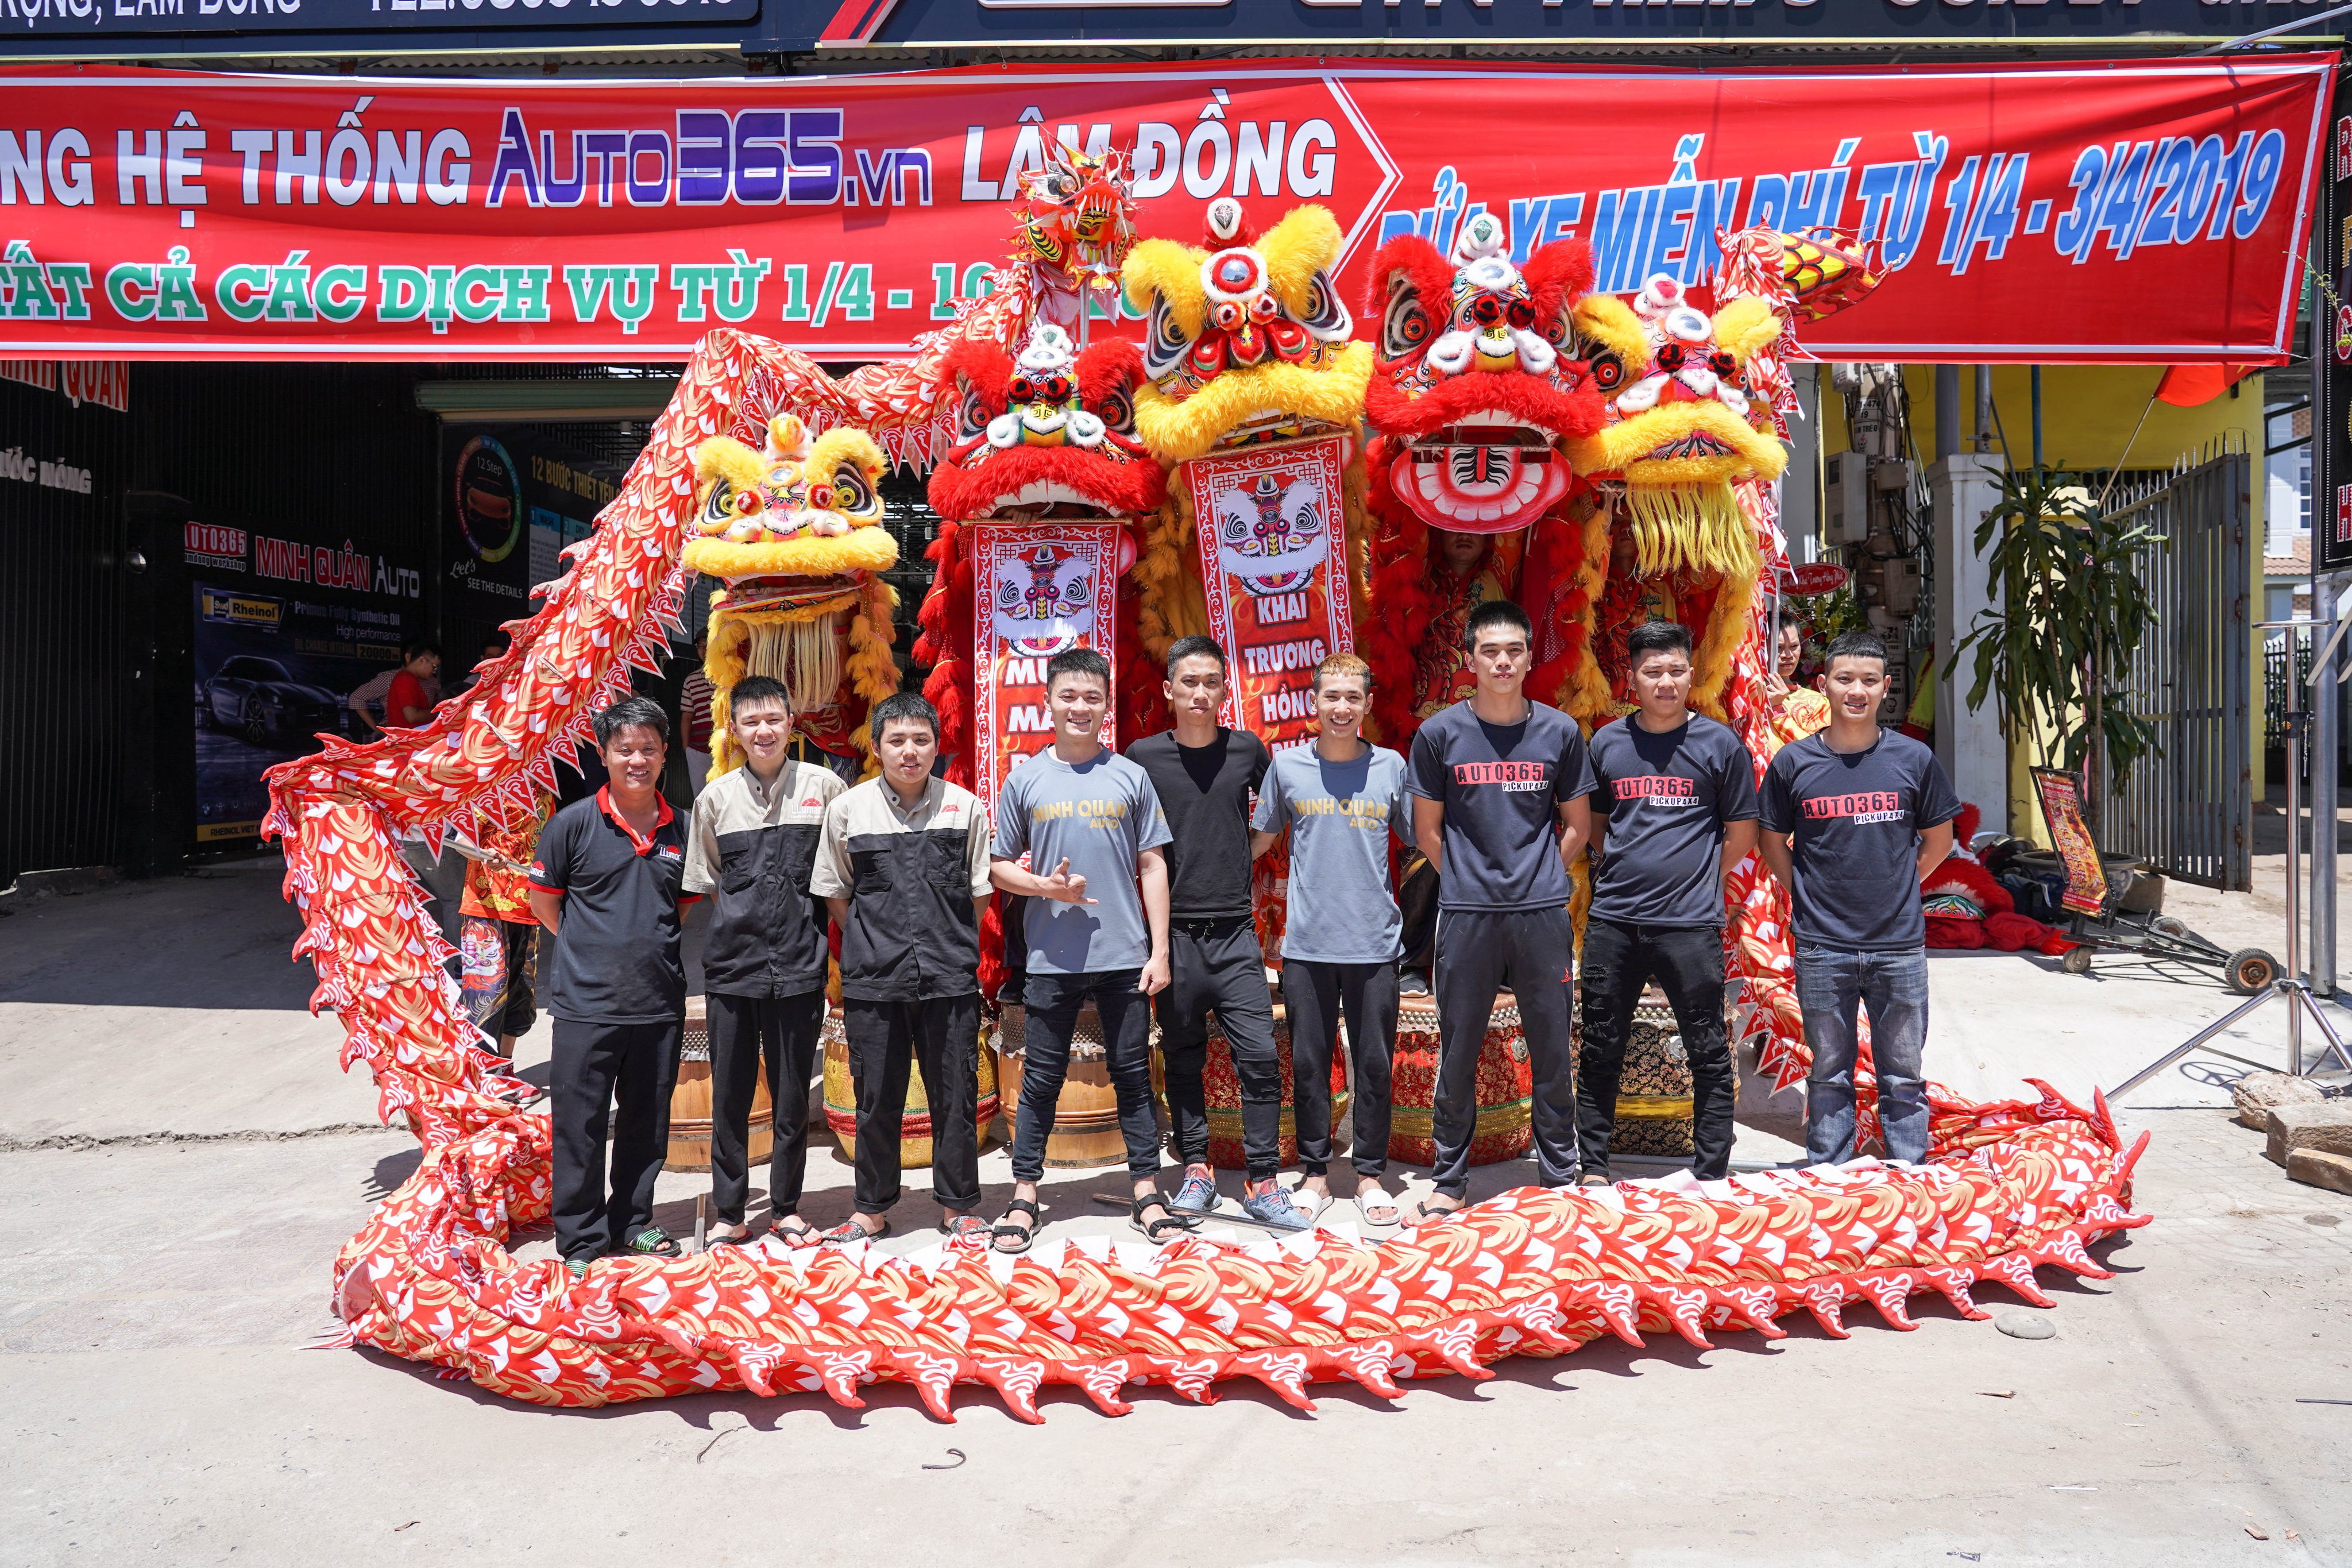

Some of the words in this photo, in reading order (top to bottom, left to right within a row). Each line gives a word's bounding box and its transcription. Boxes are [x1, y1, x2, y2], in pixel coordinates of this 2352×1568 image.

[117, 110, 207, 228] HỆ
[231, 95, 472, 206] THỐNG
[1131, 87, 1337, 199] ĐỒNG
[1591, 133, 1743, 294] MIỄN
[1856, 130, 1949, 272] TỪ
[1937, 152, 2030, 276] 1/4
[2054, 129, 2285, 265] 3/4/2019
[0, 240, 94, 320] ẤT
[105, 245, 208, 322] CẢ
[215, 250, 367, 322] CÁC
[377, 264, 551, 334] DỊCH
[563, 264, 659, 335] VỤ
[671, 249, 772, 322] TỪ
[782, 261, 875, 327] 1/4
[887, 289, 913, 308] -
[40, 457, 92, 495] NÓNG
[477, 456, 485, 470] 12
[486, 459, 503, 477] Step
[531, 455, 543, 481] 12
[546, 461, 571, 491] BƯỚC
[573, 469, 597, 501] THIẾT
[211, 557, 246, 572] workshop
[255, 535, 311, 584] MINH
[314, 538, 370, 592] QUÂN
[374, 555, 420, 598] AUTO
[468, 577, 480, 590] SEE
[481, 581, 495, 593] THE
[496, 584, 523, 598] DETAILS
[233, 603, 275, 618] Rheinol
[350, 607, 388, 624] Synthetic
[389, 613, 400, 625] Oil
[1256, 591, 1308, 625] KHAI
[336, 624, 354, 639] High
[356, 627, 401, 642] performance
[360, 646, 392, 659] 20000
[1243, 639, 1326, 675] TRƯƠNG
[1457, 763, 1542, 782] AUTO365
[1612, 778, 1691, 798] AUTO365
[1033, 801, 1073, 825] MINH
[1077, 798, 1127, 820] QUÂN
[1295, 798, 1334, 816] MINH
[1338, 798, 1387, 820] QUÂN
[1805, 793, 1895, 817] AUTO365
[211, 827, 240, 836] RHEINOL
[1090, 818, 1119, 829] AUTO
[1350, 817, 1378, 830] AUTO
